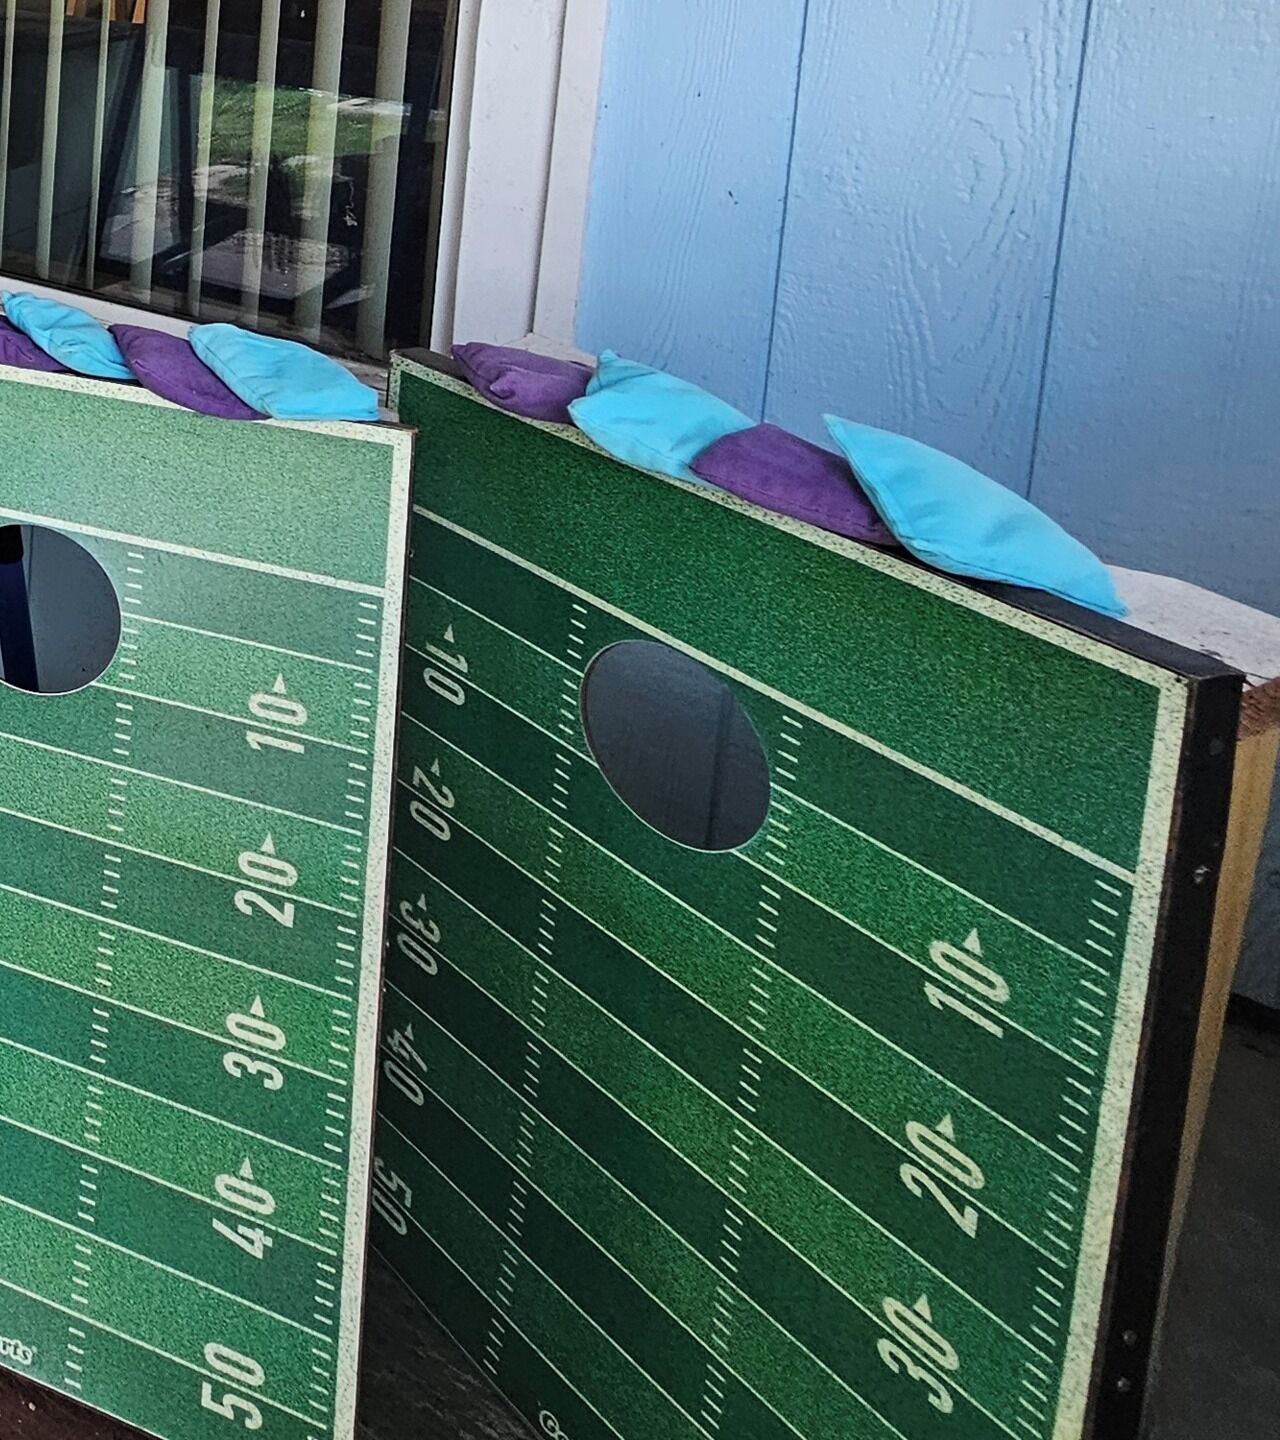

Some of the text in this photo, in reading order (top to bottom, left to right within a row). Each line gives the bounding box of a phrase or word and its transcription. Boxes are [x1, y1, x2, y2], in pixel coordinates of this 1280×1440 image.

[422, 640, 469, 706] 10
[246, 692, 308, 754] 10
[409, 764, 456, 842] 20
[234, 850, 298, 929] 20
[396, 900, 441, 976] 30
[923, 940, 1011, 1039] 10
[223, 1012, 287, 1091] 30
[383, 1028, 429, 1107] 40
[212, 1173, 276, 1260] 40
[372, 1156, 413, 1236] 50
[899, 1120, 986, 1240] 20
[201, 1342, 266, 1430] 50
[876, 1296, 960, 1414] 30
